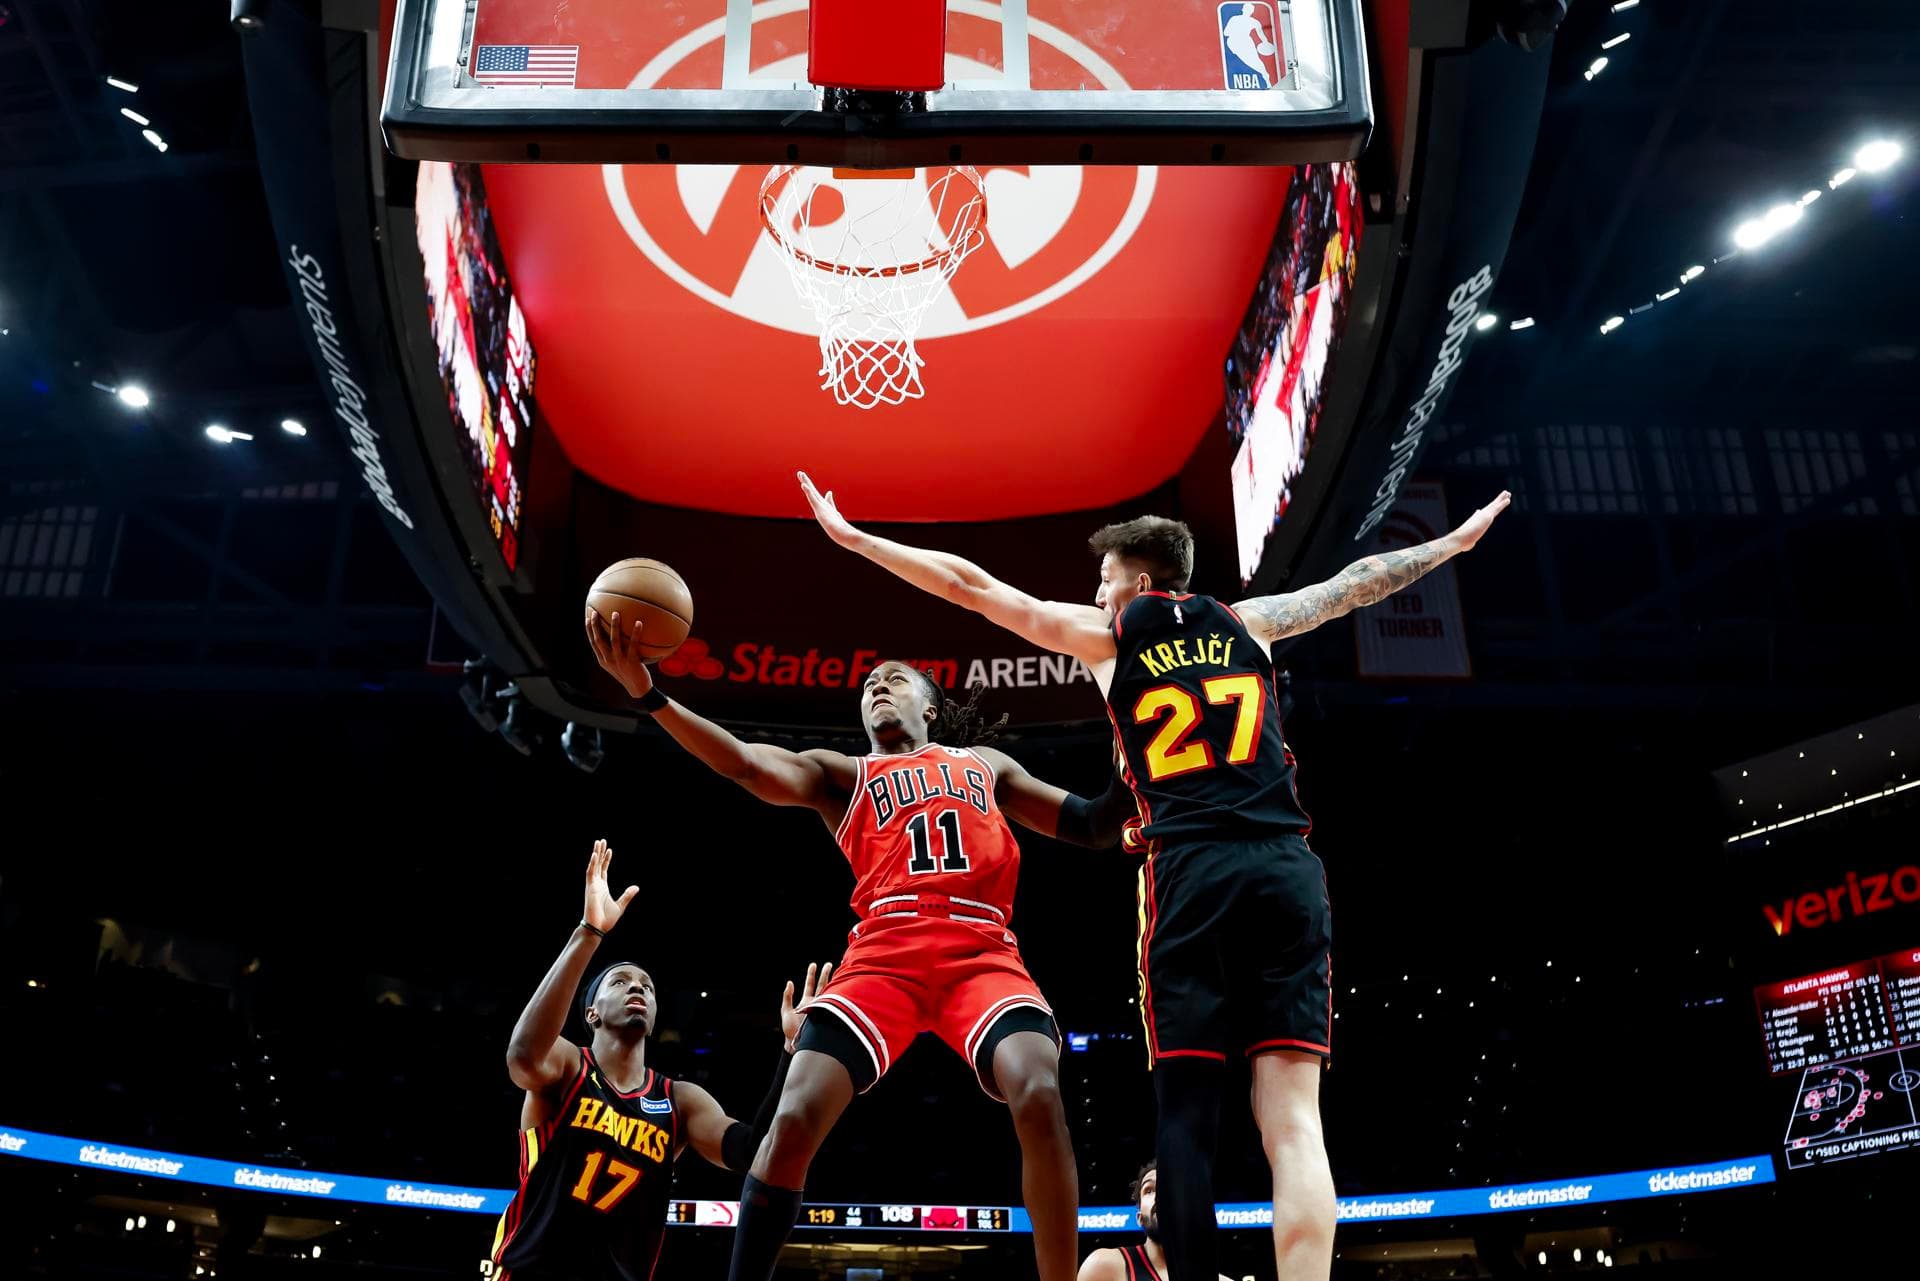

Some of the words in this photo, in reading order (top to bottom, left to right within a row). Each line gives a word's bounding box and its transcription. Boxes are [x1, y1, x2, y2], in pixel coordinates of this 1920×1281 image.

[1233, 74, 1260, 89] NBA
[1377, 617, 1444, 638] TURNER
[1139, 633, 1235, 678] KREJČÍ
[964, 655, 1094, 690] ARENA
[1132, 672, 1267, 782] 27
[866, 763, 989, 832] BULLS
[906, 808, 970, 876] 11
[1783, 978, 1819, 995] ATLANTA
[1820, 970, 1850, 985] HAWKS
[570, 1097, 670, 1163] HAWKS
[1841, 1133, 1900, 1154] CAPTIONING
[79, 1145, 184, 1175] ticketmaster
[233, 1167, 337, 1195] ticketmaster
[571, 1149, 642, 1214] 17
[1648, 1161, 1756, 1194] ticketmaster
[386, 1183, 486, 1211] ticketmaster
[1336, 1199, 1435, 1218] ticketmaster
[1488, 1183, 1593, 1209] ticketmaster
[808, 1209, 835, 1224] 1:19
[880, 1206, 914, 1223] 108
